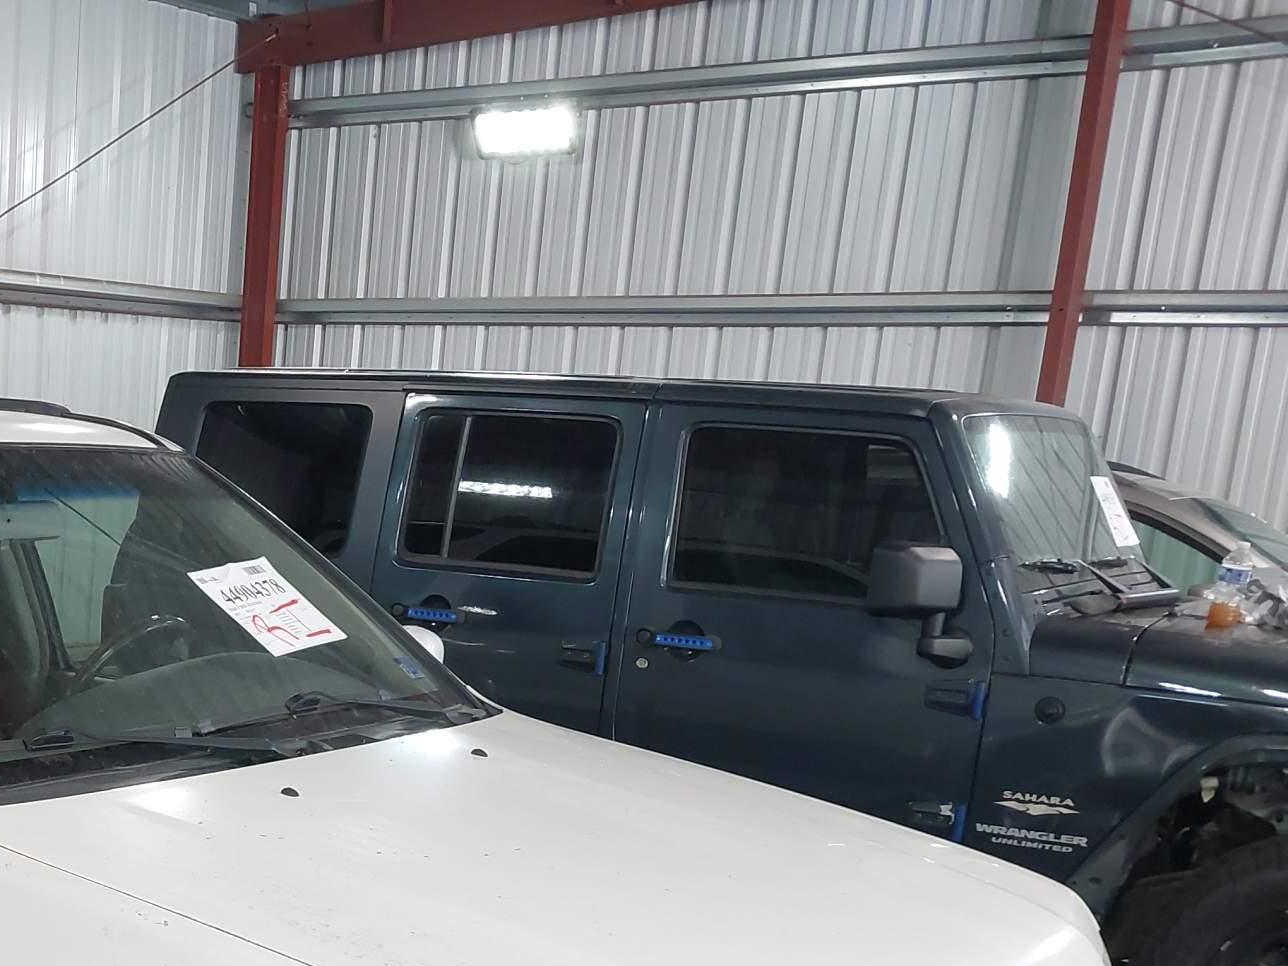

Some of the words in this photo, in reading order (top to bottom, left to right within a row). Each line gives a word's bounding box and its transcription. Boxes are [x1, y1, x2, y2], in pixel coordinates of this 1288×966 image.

[220, 579, 286, 604] 44904378
[1002, 790, 1075, 807] SAHARA
[975, 823, 1089, 847] WRANGLER
[991, 836, 1073, 853] UNLIMITED
